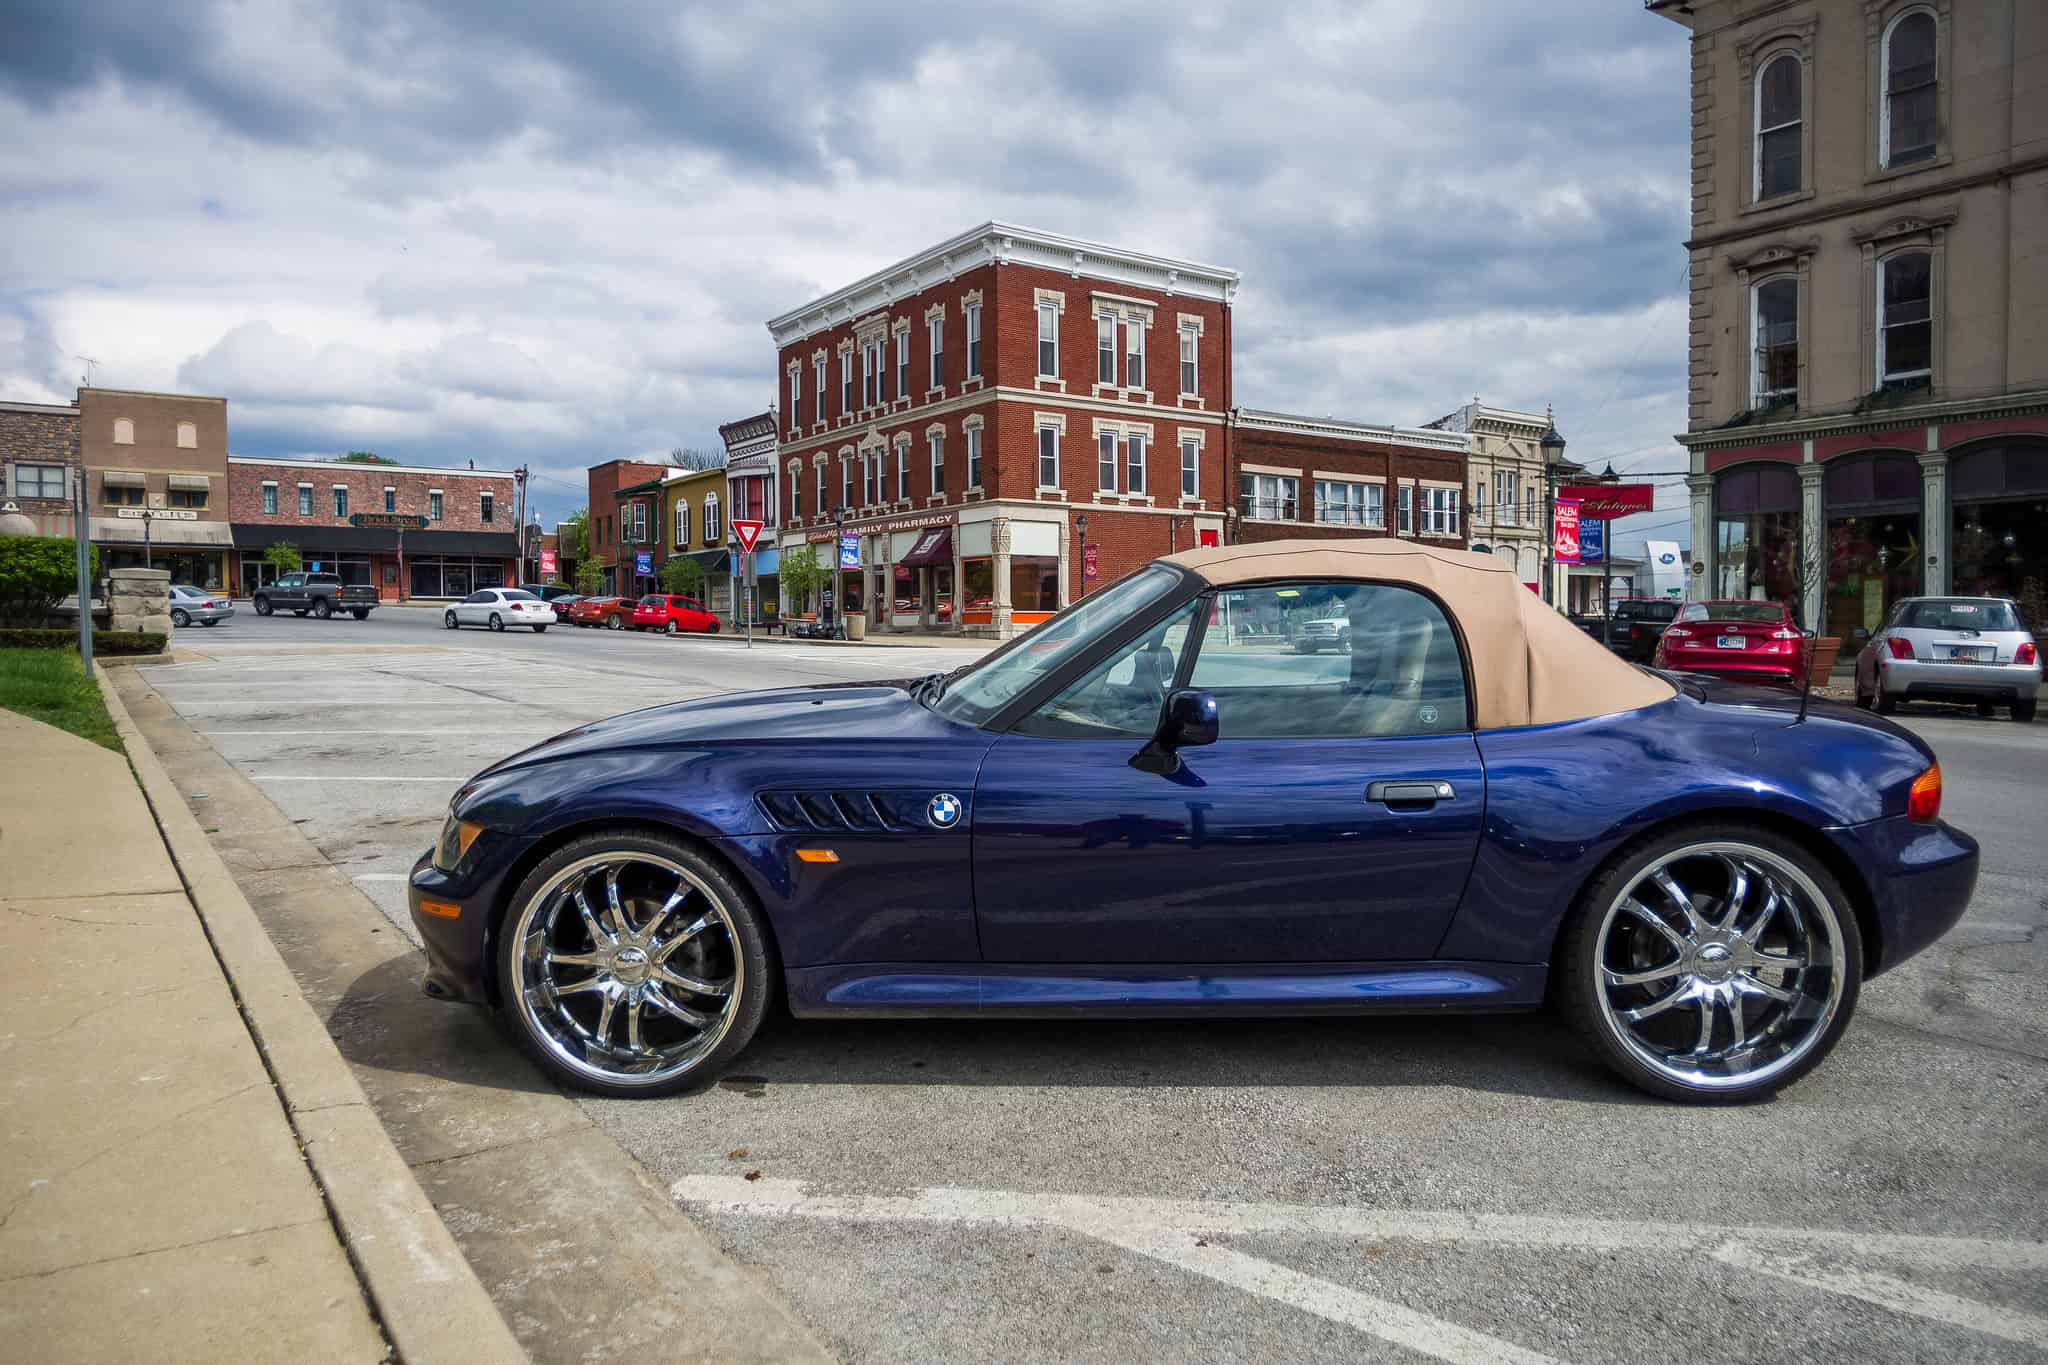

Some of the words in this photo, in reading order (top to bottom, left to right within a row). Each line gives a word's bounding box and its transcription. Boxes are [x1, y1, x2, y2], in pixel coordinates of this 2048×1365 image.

[1557, 506, 1577, 515] SALEM
[1581, 501, 1647, 512] Antiques
[847, 524, 882, 535] FAMILY
[888, 515, 953, 530] PHARMACY
